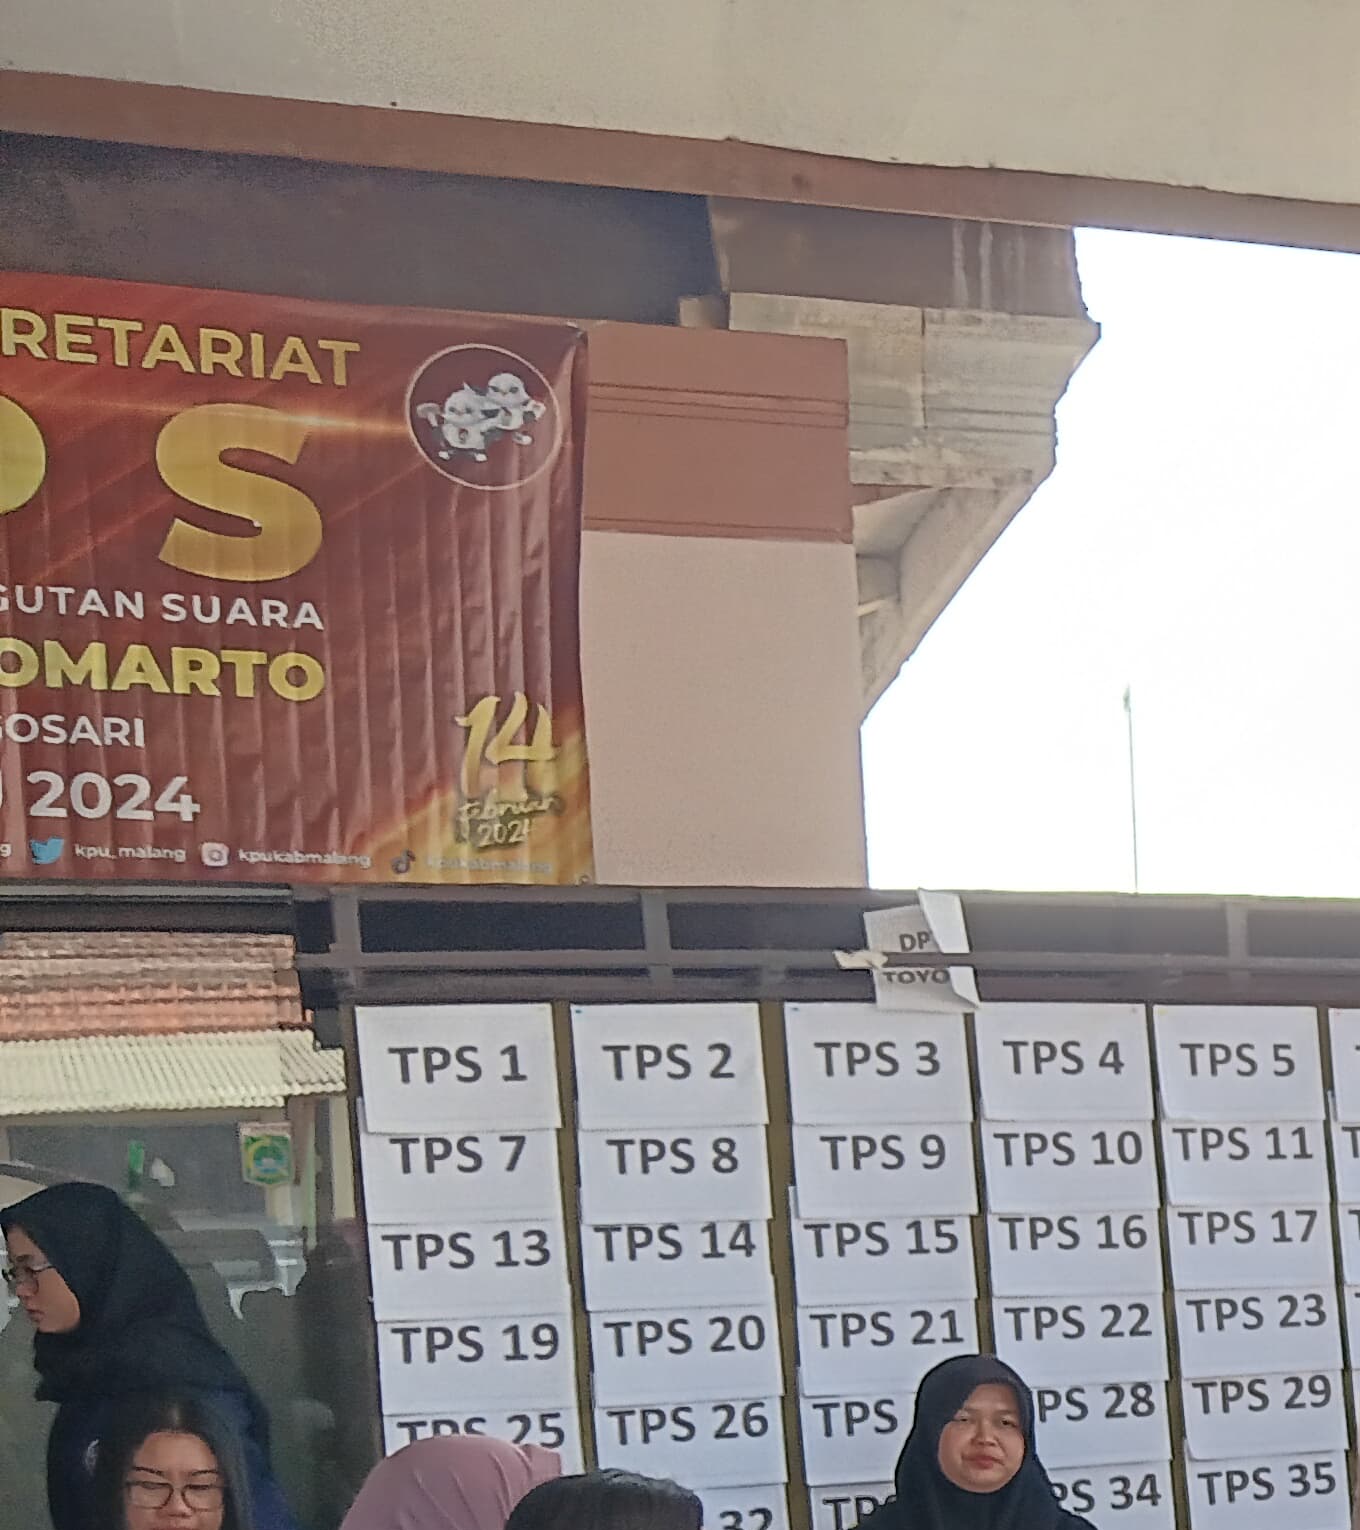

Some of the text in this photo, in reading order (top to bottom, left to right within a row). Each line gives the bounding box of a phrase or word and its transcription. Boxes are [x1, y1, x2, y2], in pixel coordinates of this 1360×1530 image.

[0, 308, 361, 385] RETARIAT
[156, 402, 322, 581] S
[162, 593, 324, 630] SUARA
[0, 637, 325, 701] OMARTO
[0, 713, 145, 748] OSARI
[27, 770, 200, 821] 2024
[899, 930, 932, 952] DP
[388, 1045, 527, 1083] TPS 1
[602, 1043, 734, 1080] TPS 2
[814, 1042, 940, 1077] TPS 3
[1003, 1041, 1124, 1075] TPS 4
[1180, 1044, 1294, 1076] TPS 5
[389, 1136, 525, 1174] TPS 7
[606, 1138, 738, 1174] TPS 8
[820, 1135, 945, 1170] TPS 9
[993, 1131, 1142, 1166] TPS 10
[1172, 1127, 1312, 1160] TPS 11
[592, 1221, 755, 1261] TPS 14
[803, 1219, 958, 1258] TPS 15
[998, 1215, 1147, 1250] TPS 16
[1178, 1210, 1317, 1244] TPS 17
[382, 1230, 550, 1270] TPS 13
[809, 1310, 963, 1348] TPS 21
[1004, 1303, 1152, 1341] TPS 22
[1186, 1297, 1263, 1332] TPS
[1278, 1294, 1326, 1327] 23
[391, 1324, 558, 1364] TPS 19
[603, 1315, 765, 1357] TPS 20
[1037, 1382, 1155, 1423] PS 28
[1192, 1375, 1331, 1414] TPS 29
[507, 1412, 565, 1449] 25
[607, 1402, 768, 1445] TPS 26
[813, 1399, 897, 1437] TPS
[1050, 1474, 1161, 1513] PS 34
[1198, 1462, 1335, 1505] TPS 35
